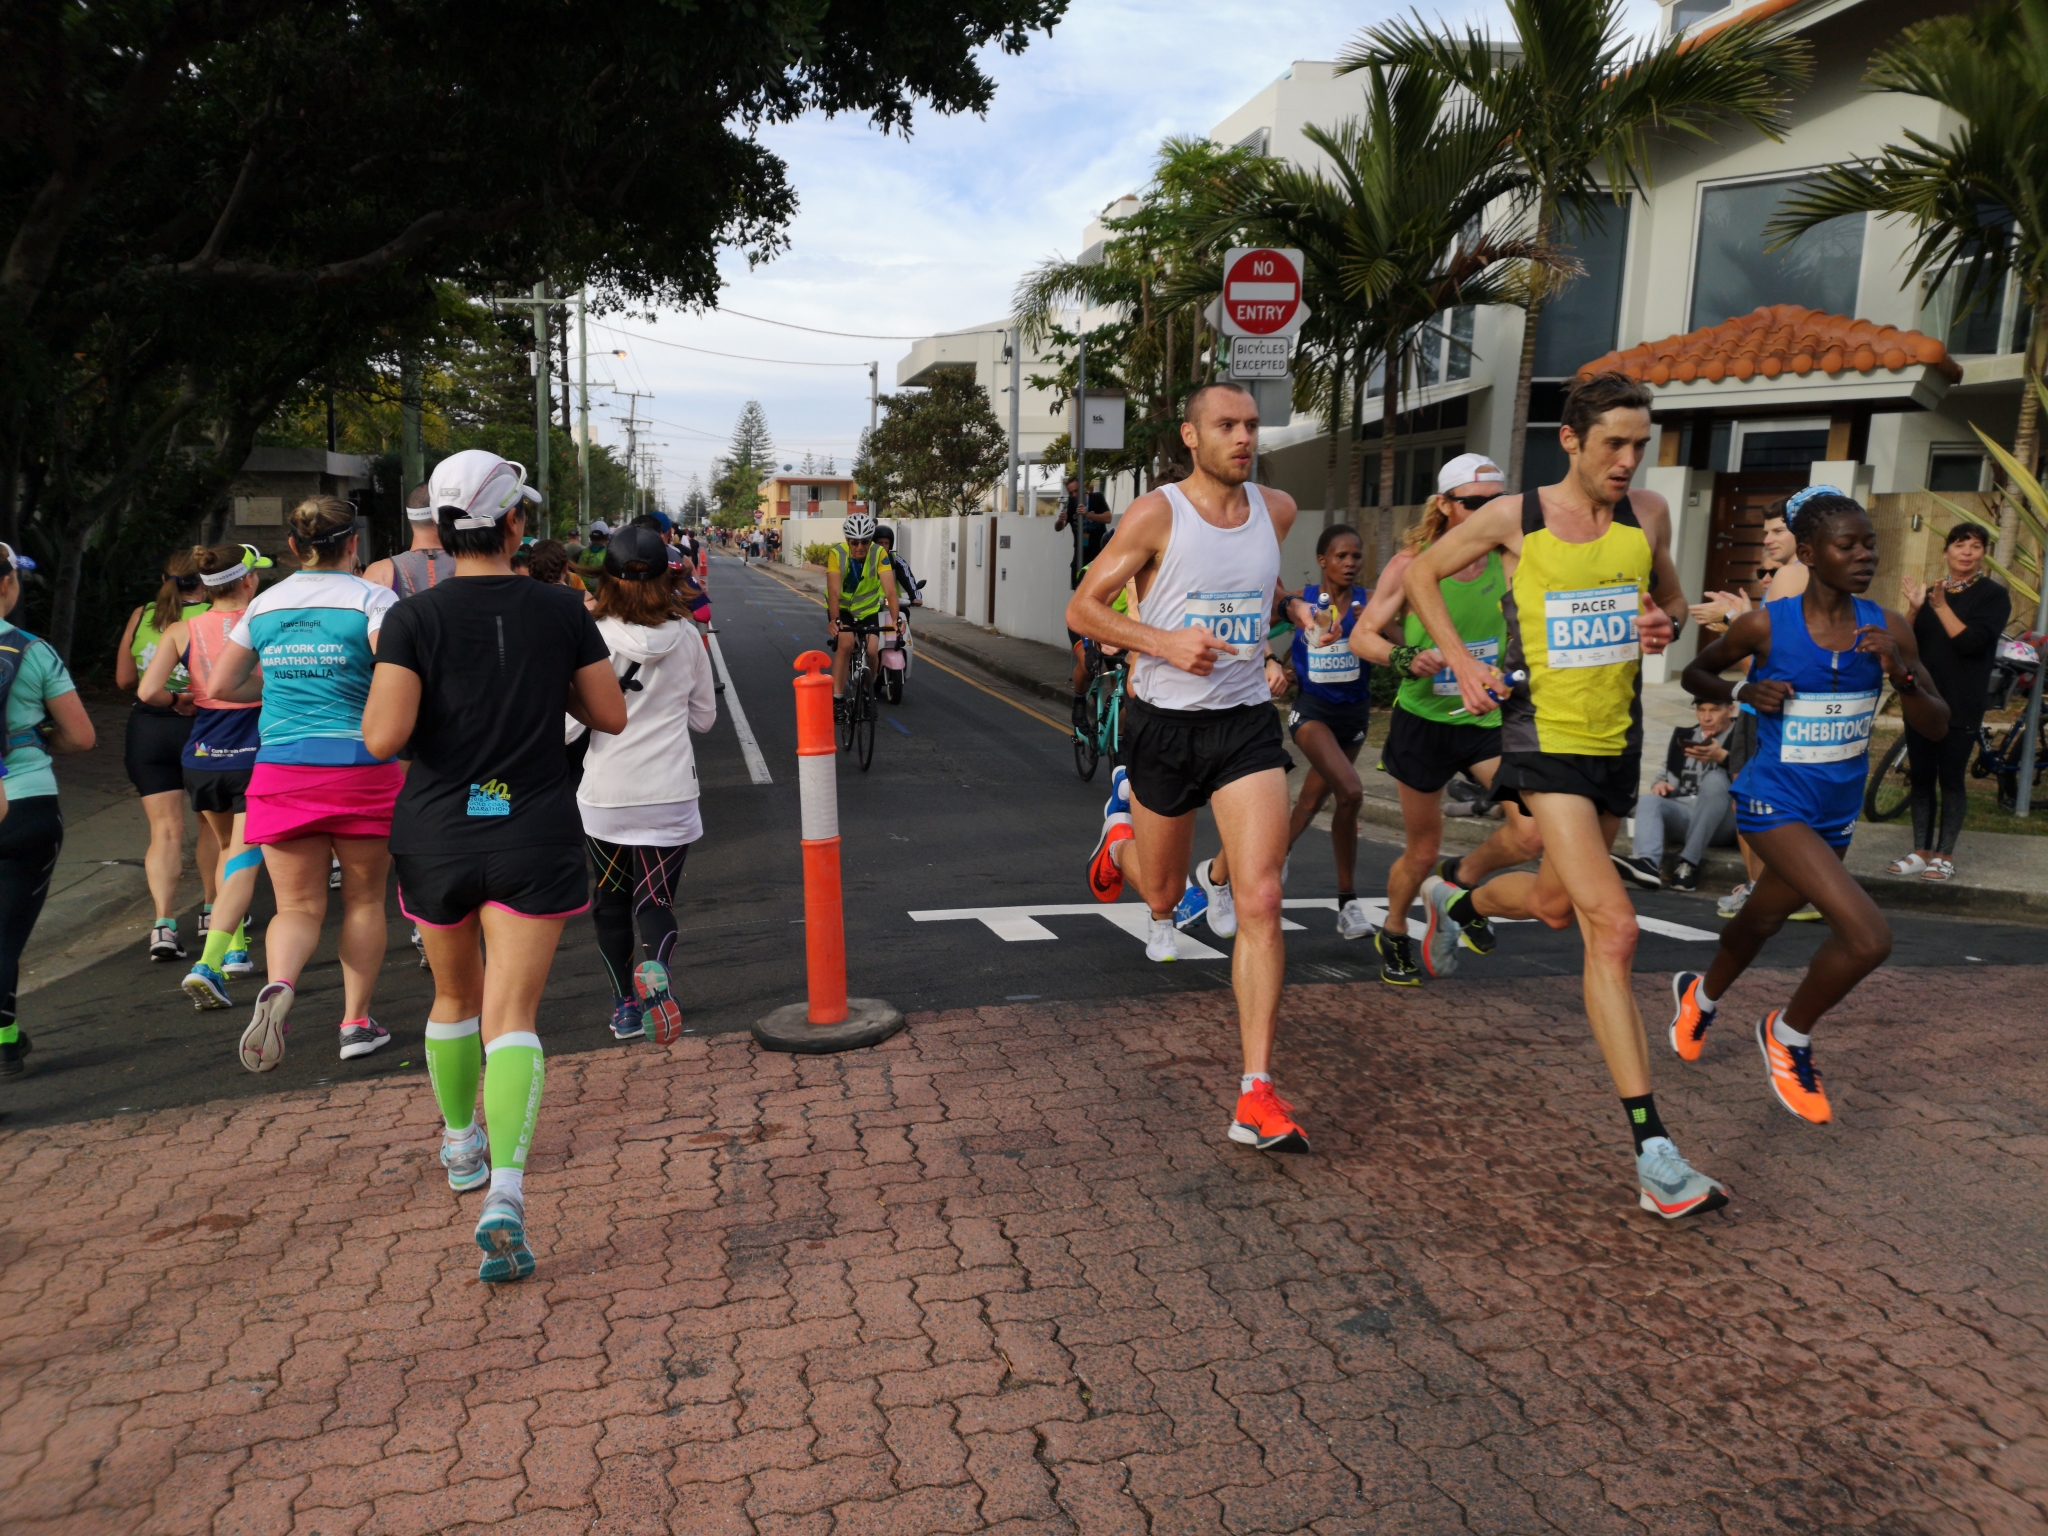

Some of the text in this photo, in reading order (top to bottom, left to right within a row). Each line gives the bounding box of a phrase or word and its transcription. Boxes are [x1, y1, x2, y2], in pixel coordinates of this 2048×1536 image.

[1253, 260, 1274, 276] NO
[1236, 304, 1286, 321] ENTRY
[1237, 344, 1285, 354] BICYCLES
[1235, 360, 1285, 370] EXCEPTED
[1219, 602, 1234, 613] 36
[1571, 599, 1616, 614] PACER
[279, 620, 321, 629] TravellingFit
[1553, 615, 1626, 647] BRAD
[263, 643, 344, 655] NEW YORK CITY
[1330, 645, 1339, 653] 51
[262, 655, 347, 667] MARATHON 2016
[1309, 655, 1355, 669] BARSOSIO
[273, 668, 334, 680] AUSTRALIA
[1834, 692, 1865, 700] MARATHON
[1825, 704, 1842, 715] 52
[1785, 718, 1864, 742] CHEBITOK
